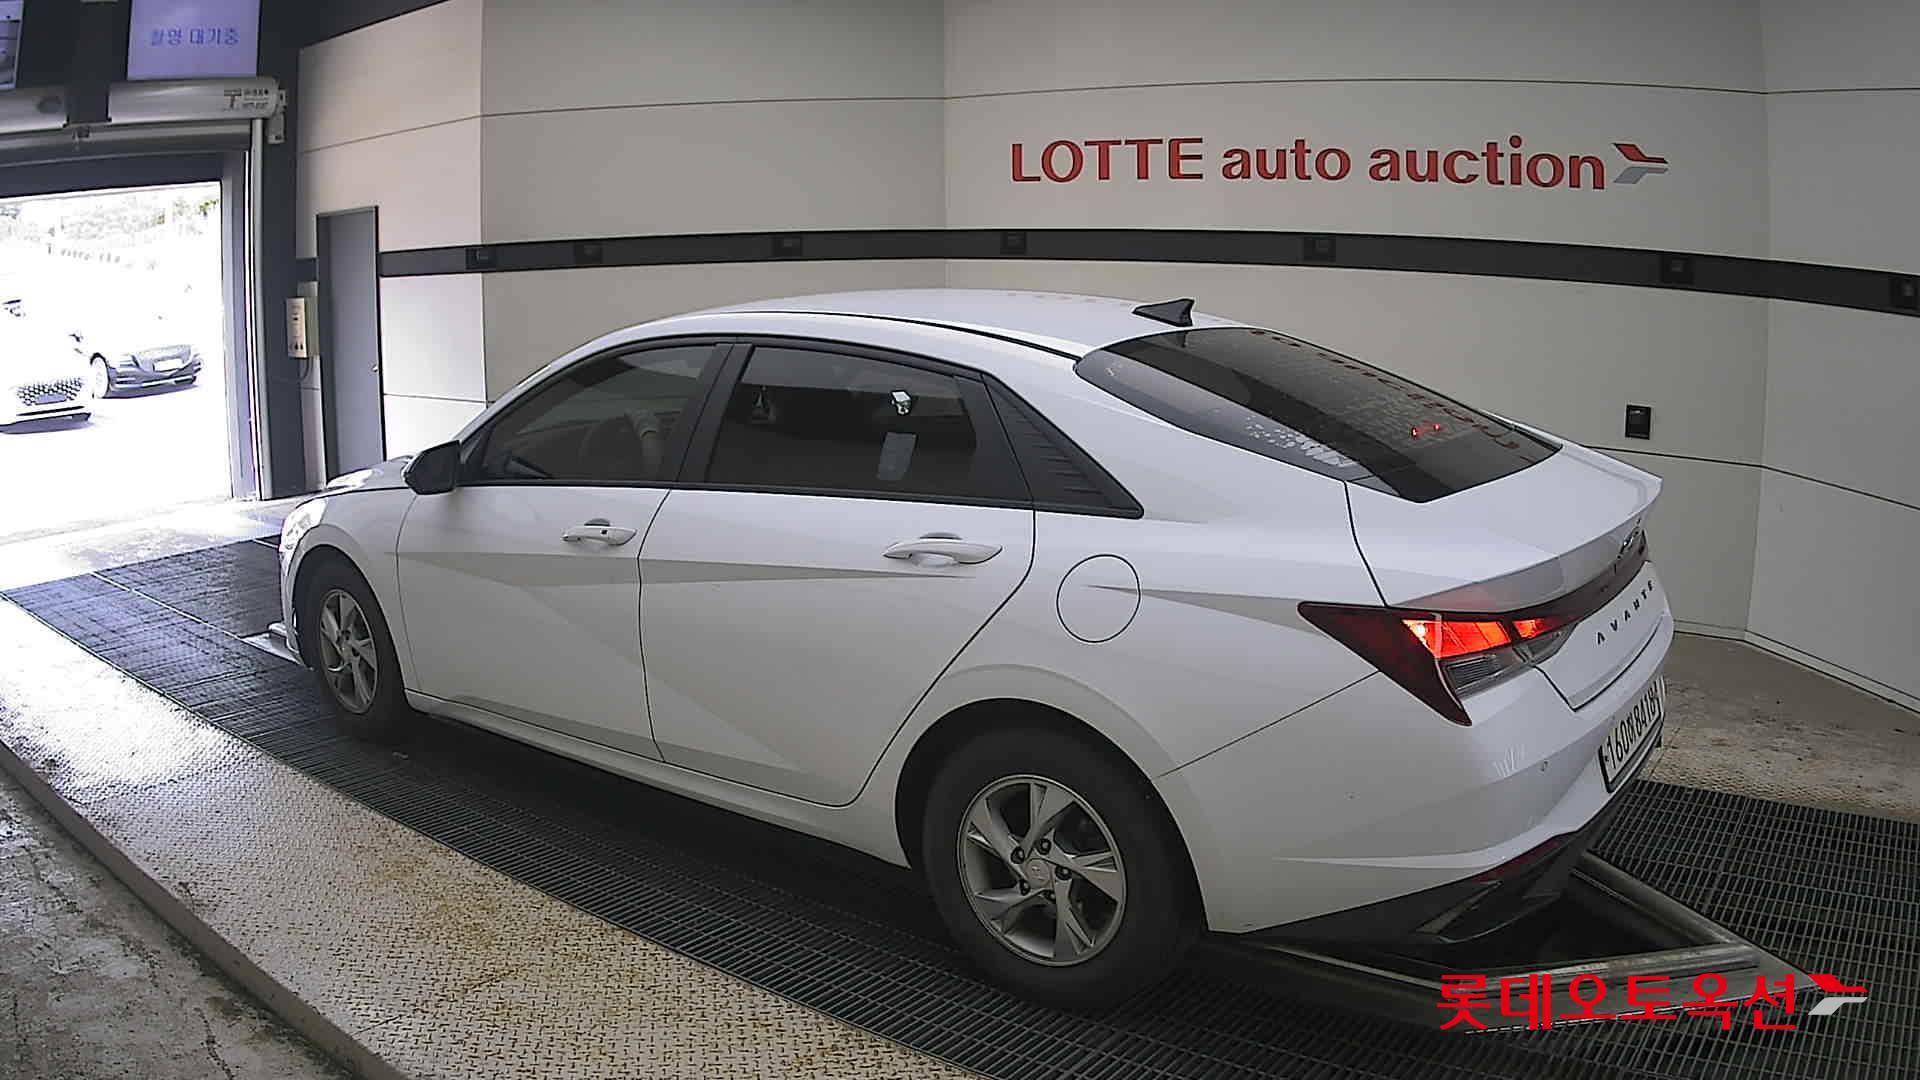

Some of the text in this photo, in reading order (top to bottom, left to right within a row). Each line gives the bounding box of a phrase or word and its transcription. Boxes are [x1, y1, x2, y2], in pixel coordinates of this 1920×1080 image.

[189, 27, 241, 46] 대기중
[1010, 136, 1606, 190] LOTTE auto auction
[1596, 578, 1654, 646] AVANTE
